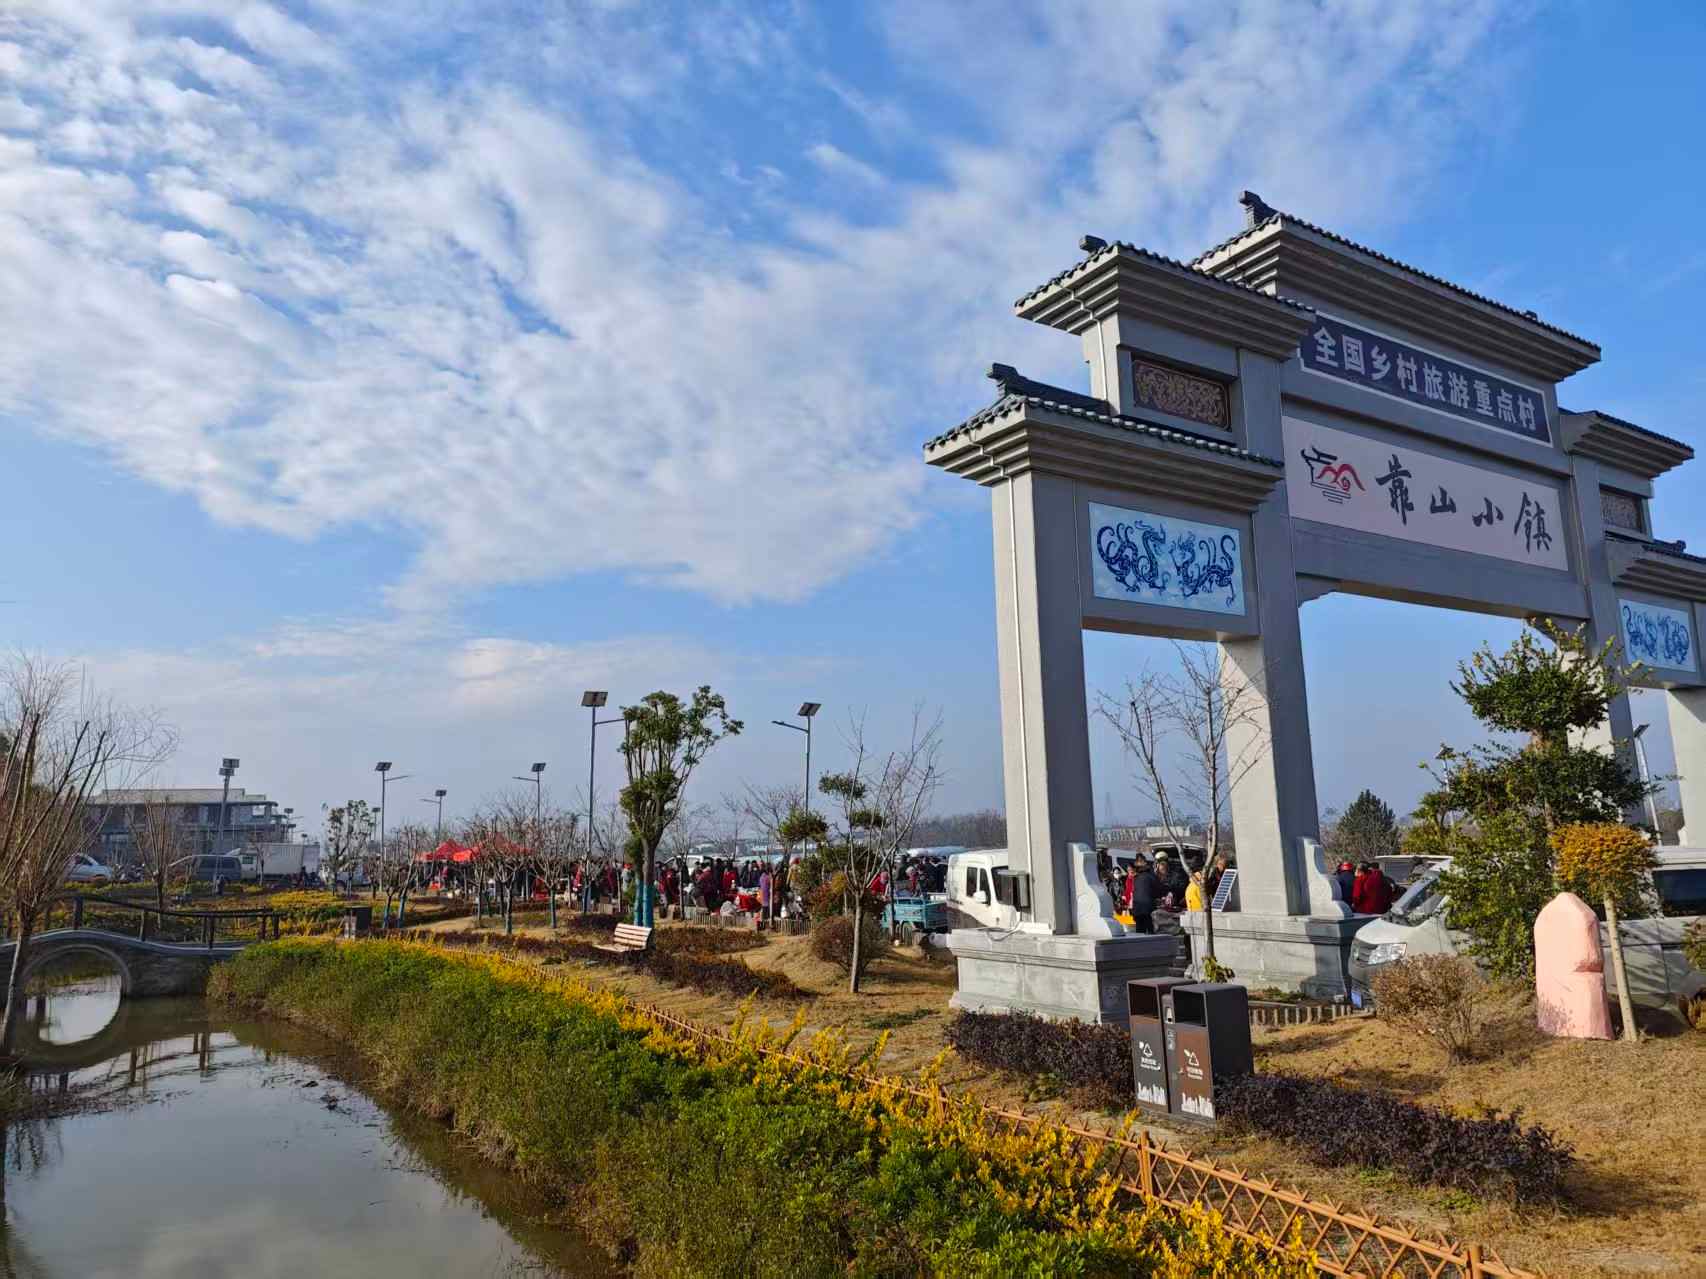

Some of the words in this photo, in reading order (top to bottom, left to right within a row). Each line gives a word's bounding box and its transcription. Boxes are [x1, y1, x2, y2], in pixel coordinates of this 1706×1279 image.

[1313, 326, 1536, 430] 全国乡村旅游重点村
[1376, 454, 1552, 552] 靠山小镇
